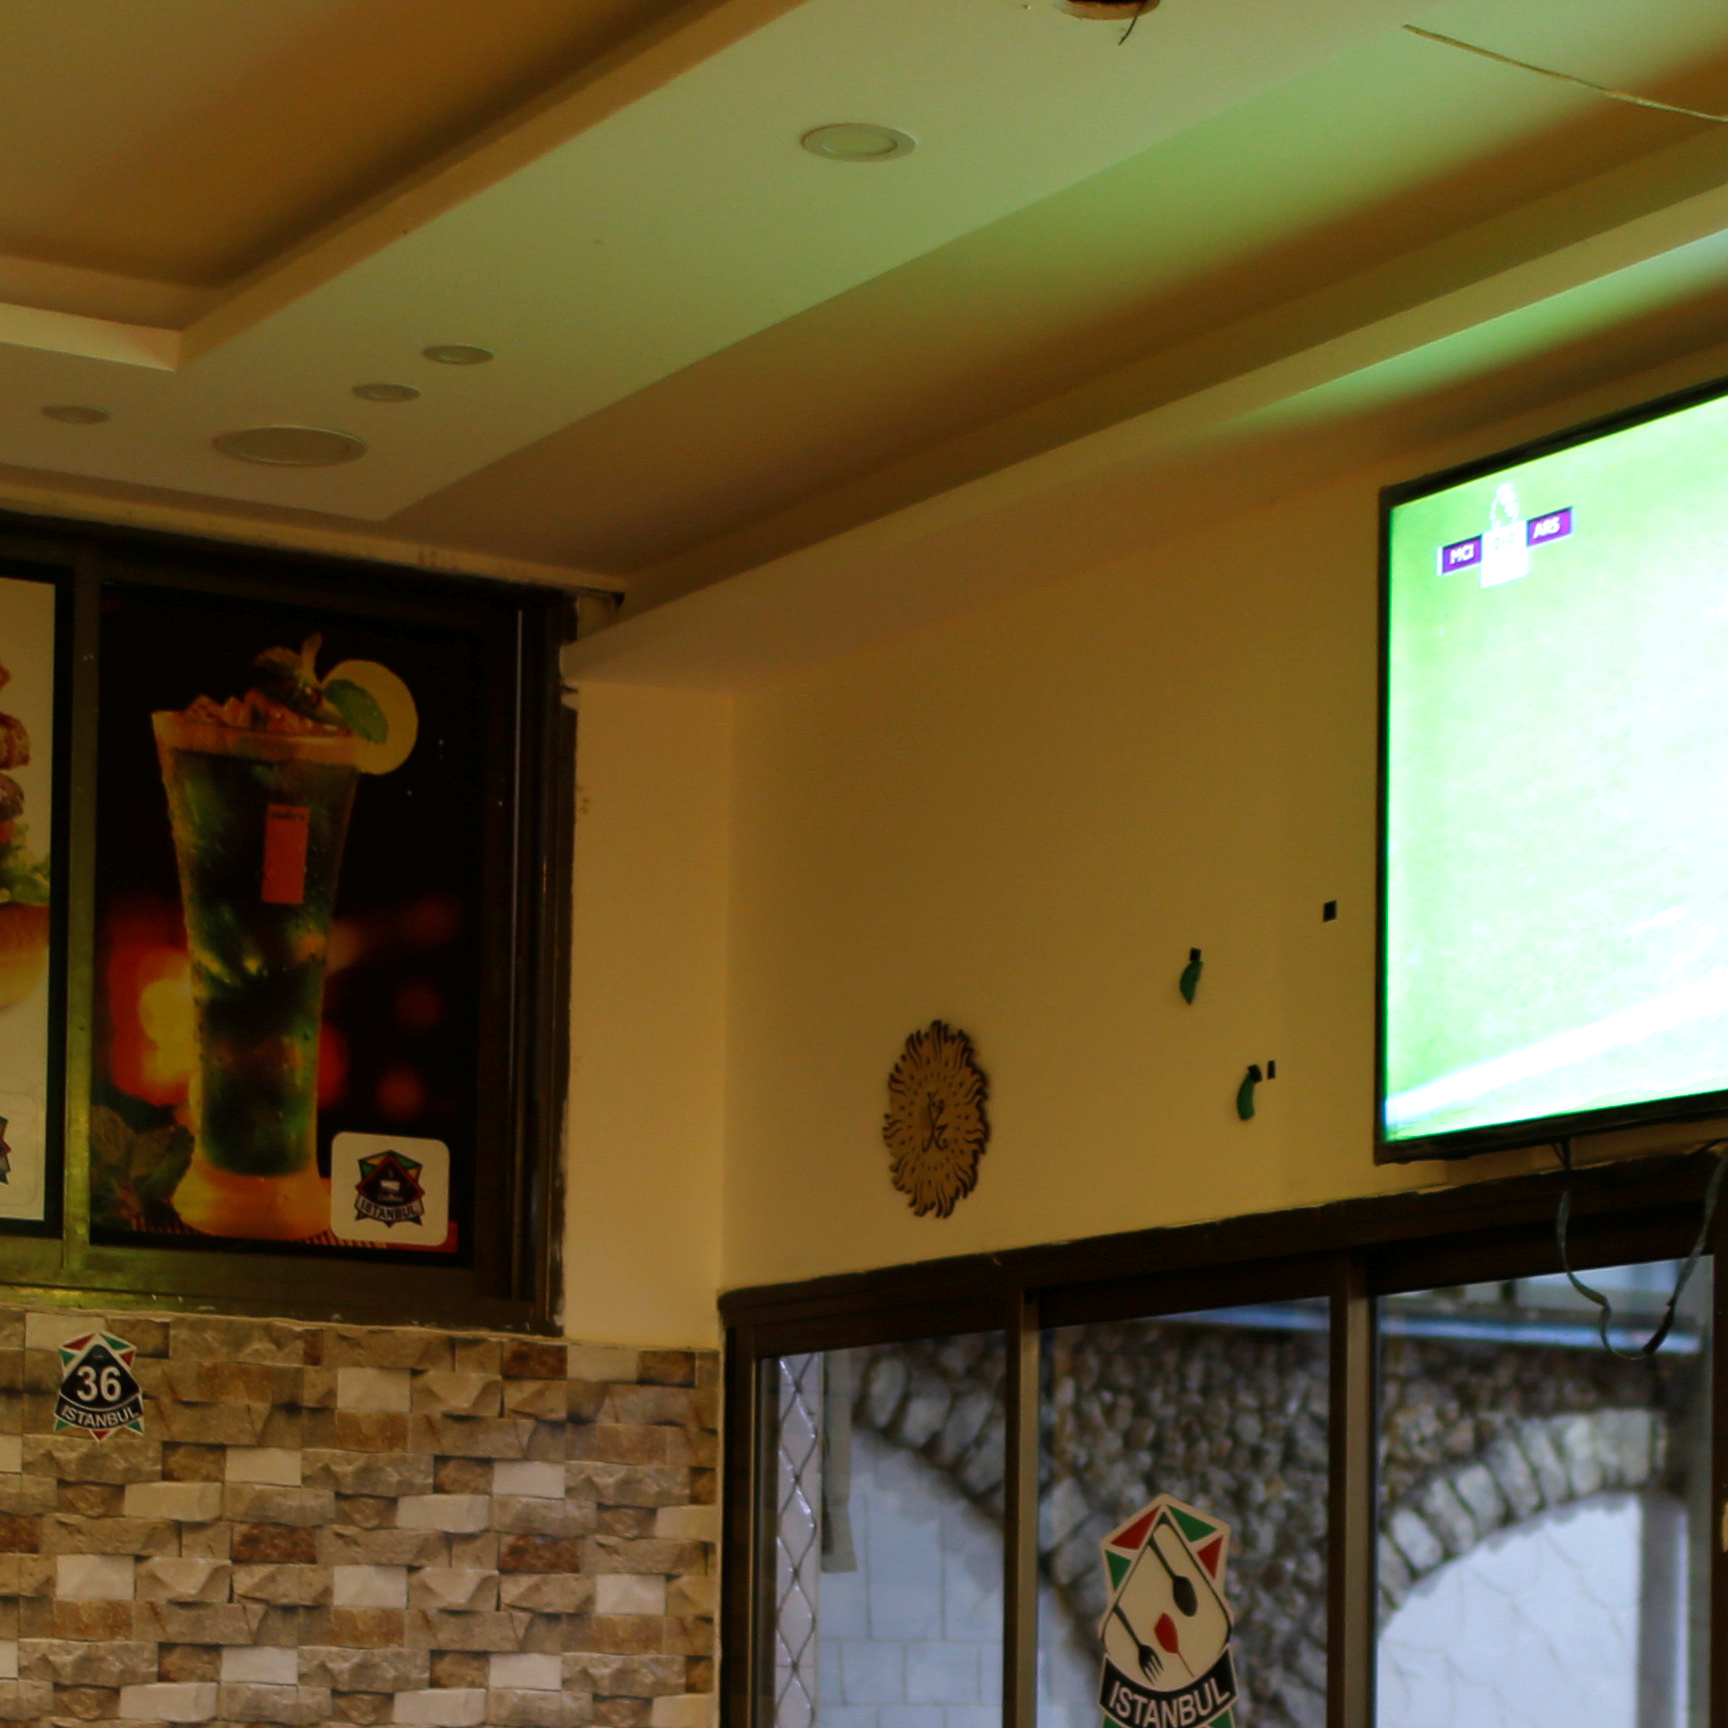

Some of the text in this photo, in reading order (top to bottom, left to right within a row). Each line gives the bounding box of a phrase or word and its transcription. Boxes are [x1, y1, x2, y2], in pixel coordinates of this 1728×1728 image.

[359, 1198, 417, 1219] ISTANBUL
[76, 1365, 122, 1402] 36
[61, 1405, 140, 1427] ISTANBUL
